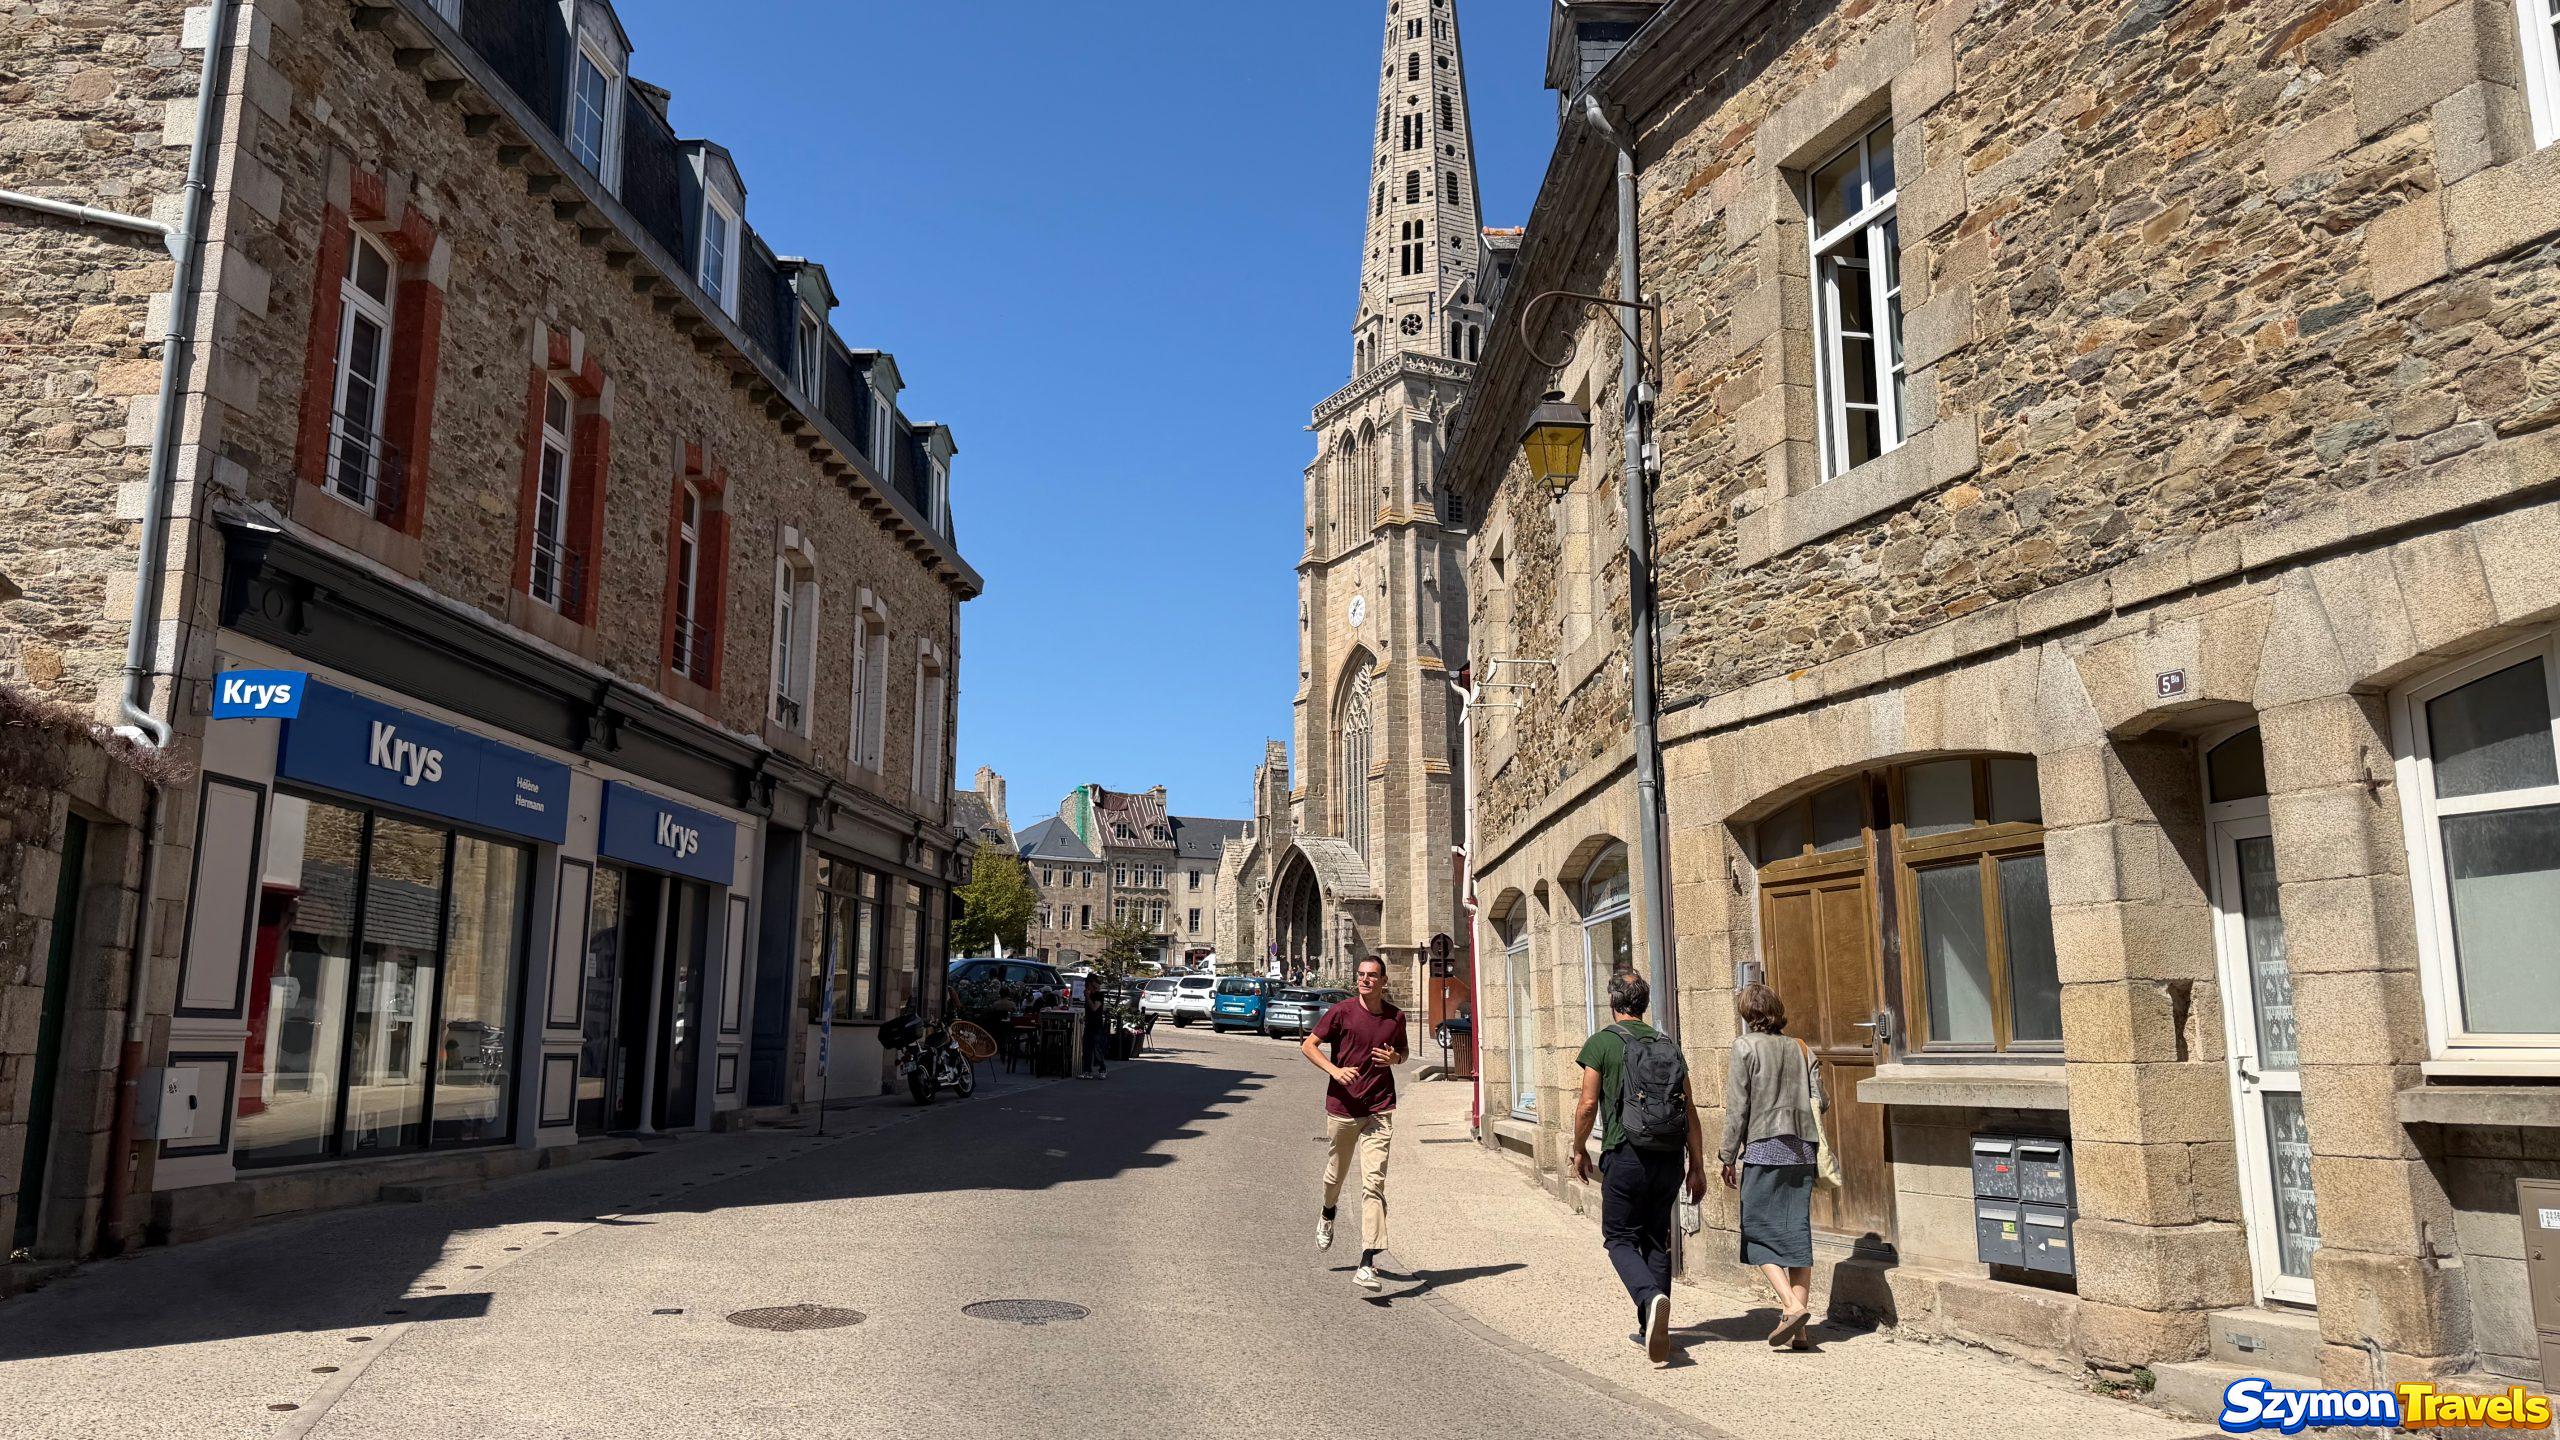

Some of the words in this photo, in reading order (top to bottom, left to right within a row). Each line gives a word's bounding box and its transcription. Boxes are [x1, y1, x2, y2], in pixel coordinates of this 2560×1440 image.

[222, 679, 291, 710] Krys
[2162, 676, 2171, 693] 5
[369, 720, 443, 787] Krys
[516, 776, 539, 793] Hélène
[515, 793, 545, 812] Hermann
[656, 811, 699, 858] Krys
